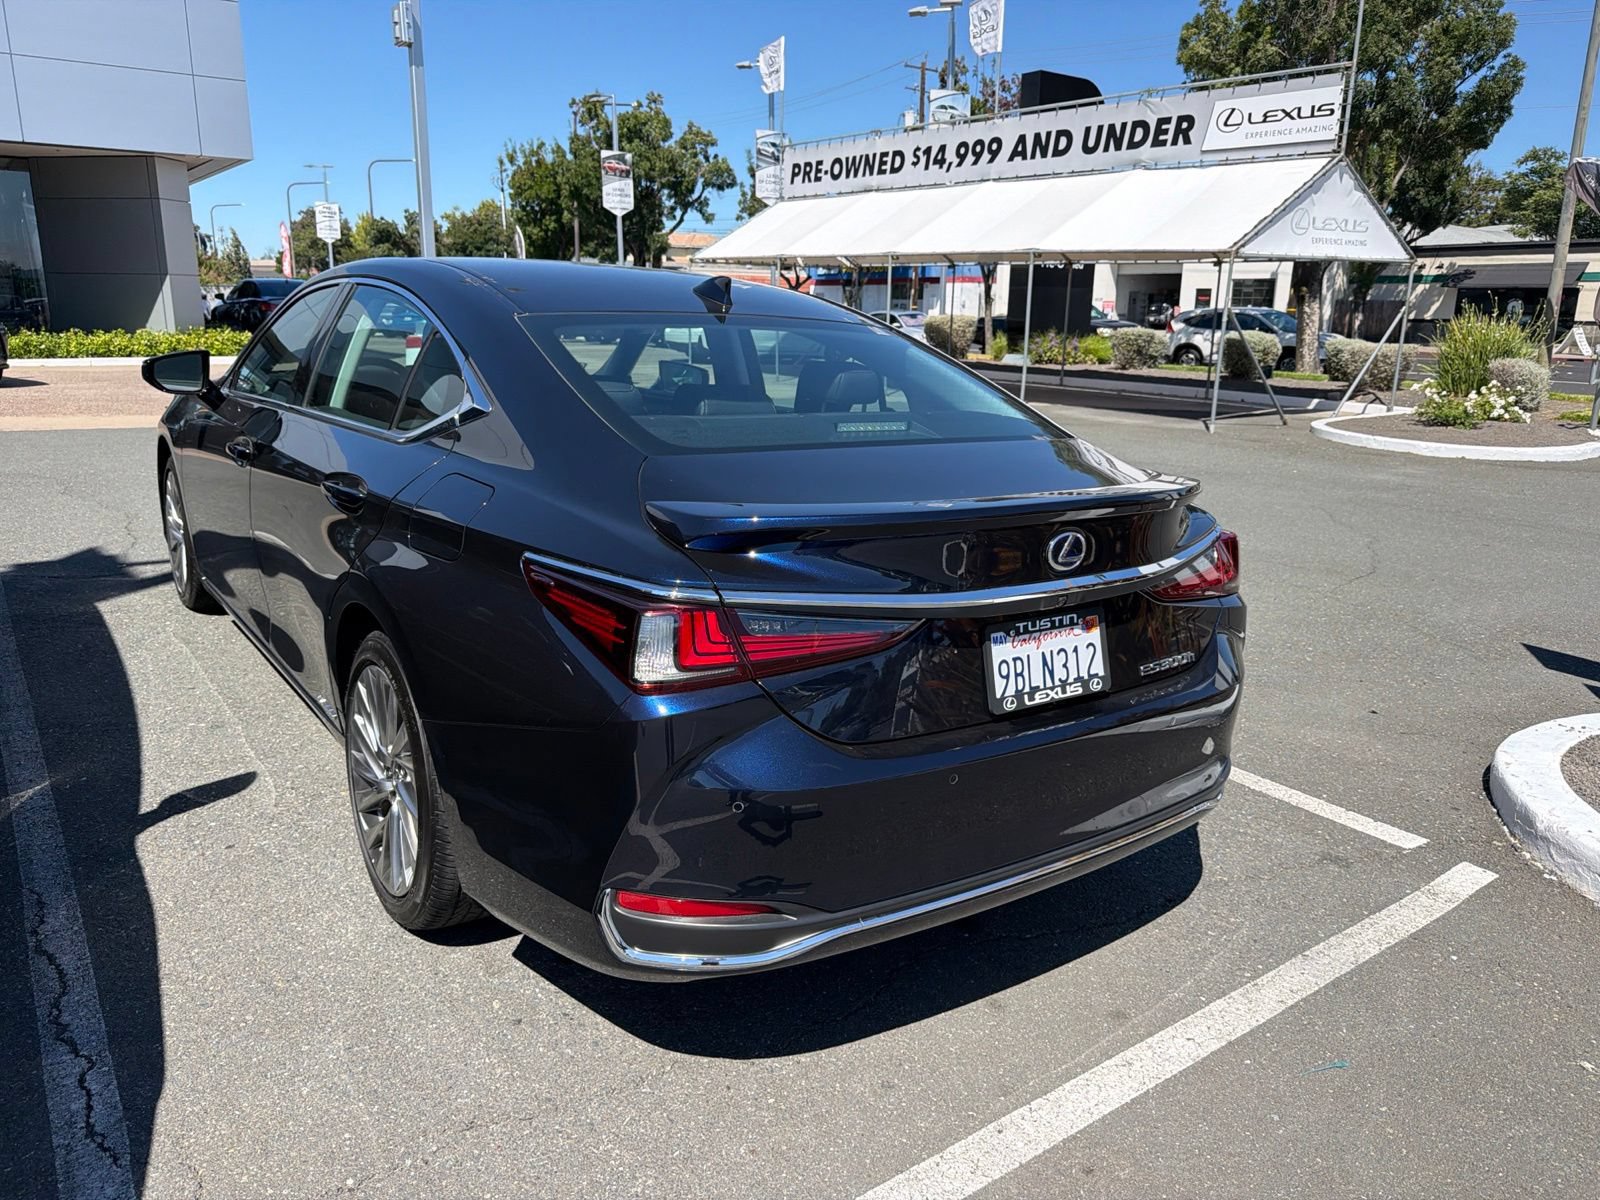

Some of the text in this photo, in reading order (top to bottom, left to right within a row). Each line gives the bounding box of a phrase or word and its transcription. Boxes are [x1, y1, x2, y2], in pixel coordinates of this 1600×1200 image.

[1248, 102, 1335, 124] LEXUS
[1245, 123, 1334, 139] EXPERIENCE AMAZING
[790, 114, 1196, 185] PRE-OWNED $14,999 AND UNDER
[1312, 216, 1369, 233] LEXUS
[1311, 237, 1368, 247] EXPERIENCE AMAZING
[1016, 614, 1077, 633] TUSTIN
[992, 634, 1008, 646] MAY
[998, 642, 1099, 697] 9BLN312
[1024, 682, 1083, 705] LEXUS
